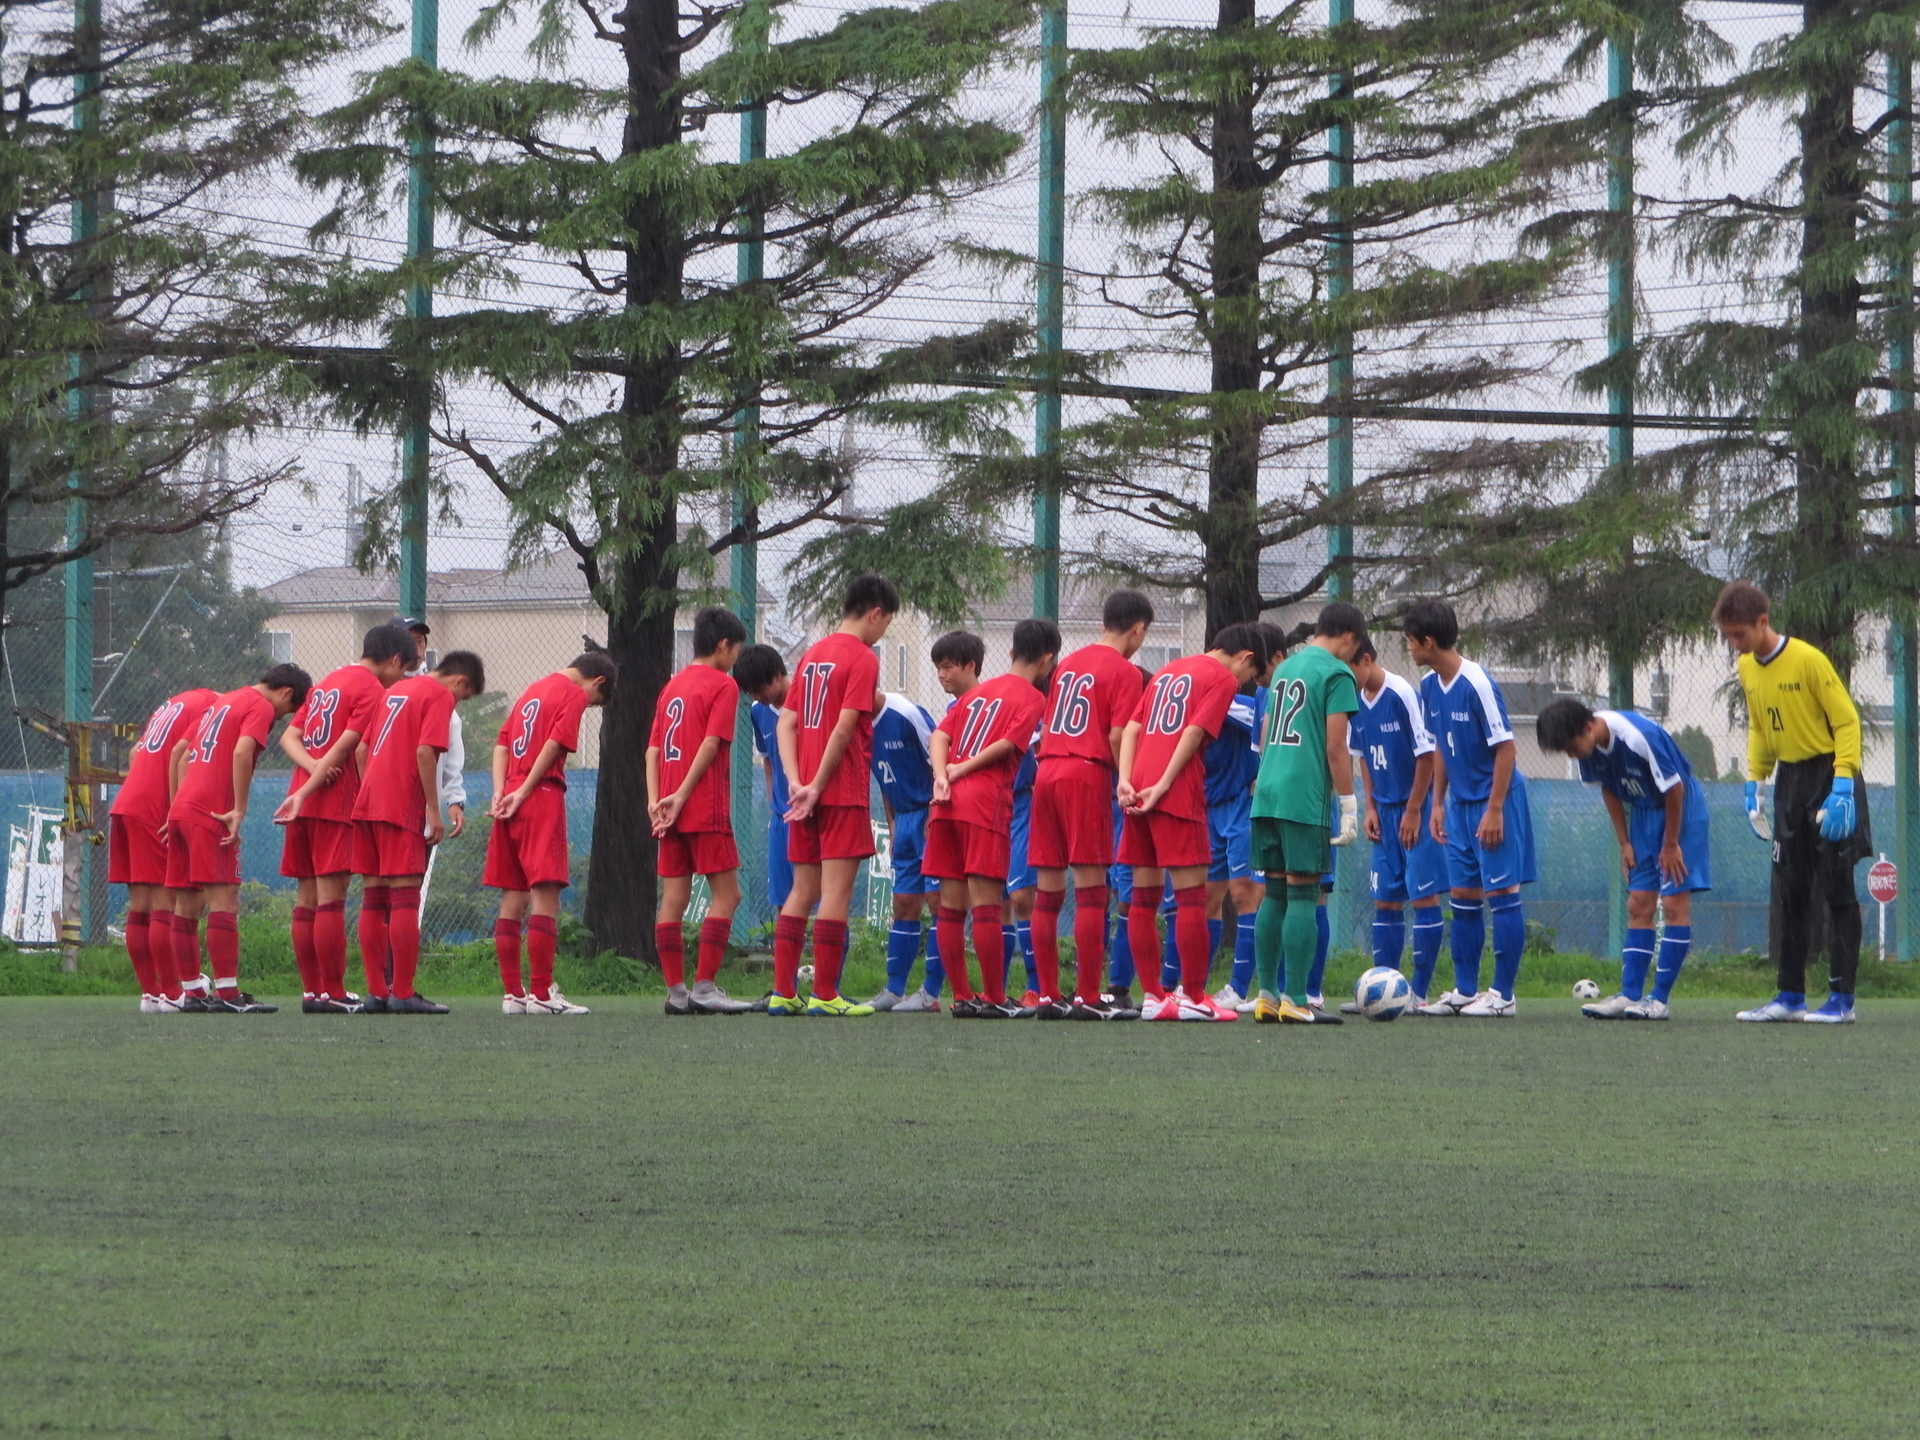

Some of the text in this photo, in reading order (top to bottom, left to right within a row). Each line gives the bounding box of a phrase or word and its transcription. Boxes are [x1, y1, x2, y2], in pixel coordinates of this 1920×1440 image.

[303, 688, 340, 750] 23
[373, 695, 409, 756] 7
[802, 662, 836, 728] 17
[1049, 670, 1095, 737] 16
[1146, 673, 1191, 735] 18
[1269, 678, 1306, 746] 12
[1767, 707, 1784, 731] 21
[189, 705, 231, 763] 24
[513, 698, 540, 758] 3
[664, 697, 684, 762] 2
[956, 696, 1003, 758] 11
[1369, 744, 1387, 771] 24
[1447, 731, 1455, 757] 9
